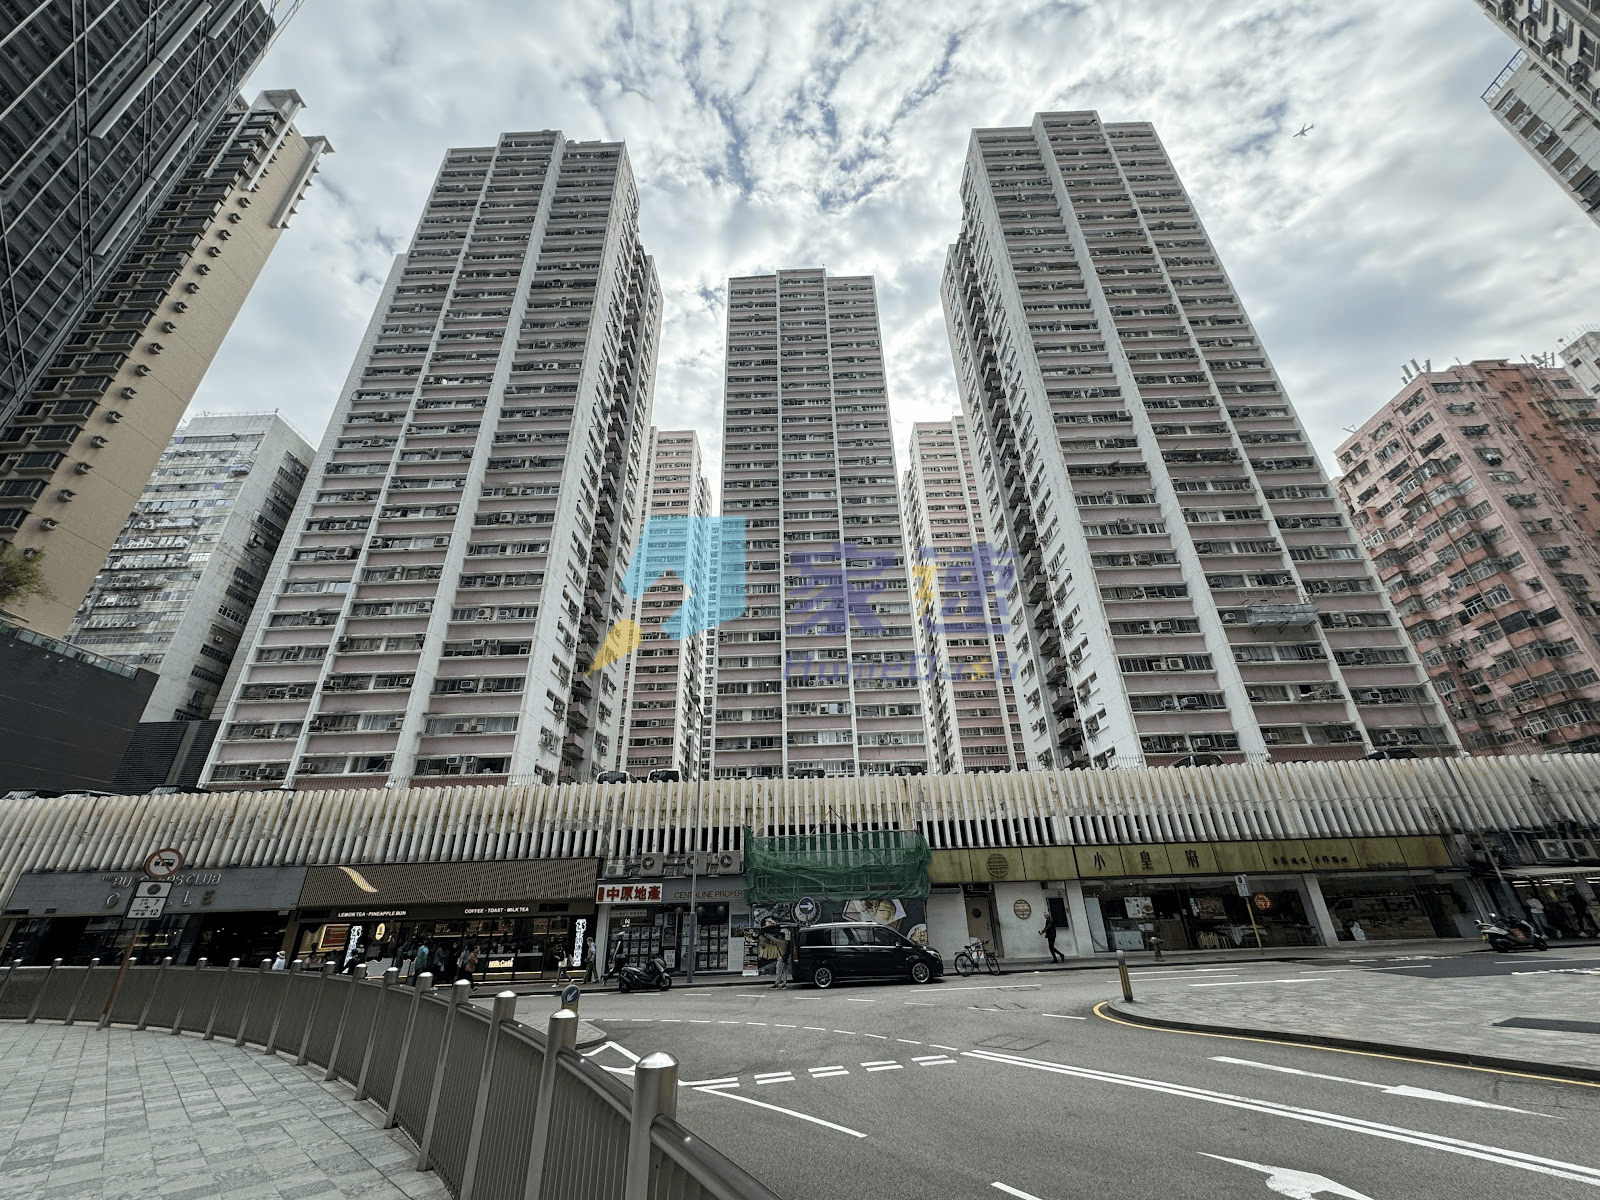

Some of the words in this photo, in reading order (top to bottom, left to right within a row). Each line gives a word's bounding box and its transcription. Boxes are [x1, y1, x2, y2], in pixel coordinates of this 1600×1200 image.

[1094, 849, 1200, 871] 小皇府
[186, 873, 222, 886] CLUB
[606, 885, 661, 901] 中原地產
[149, 908, 159, 916] 12
